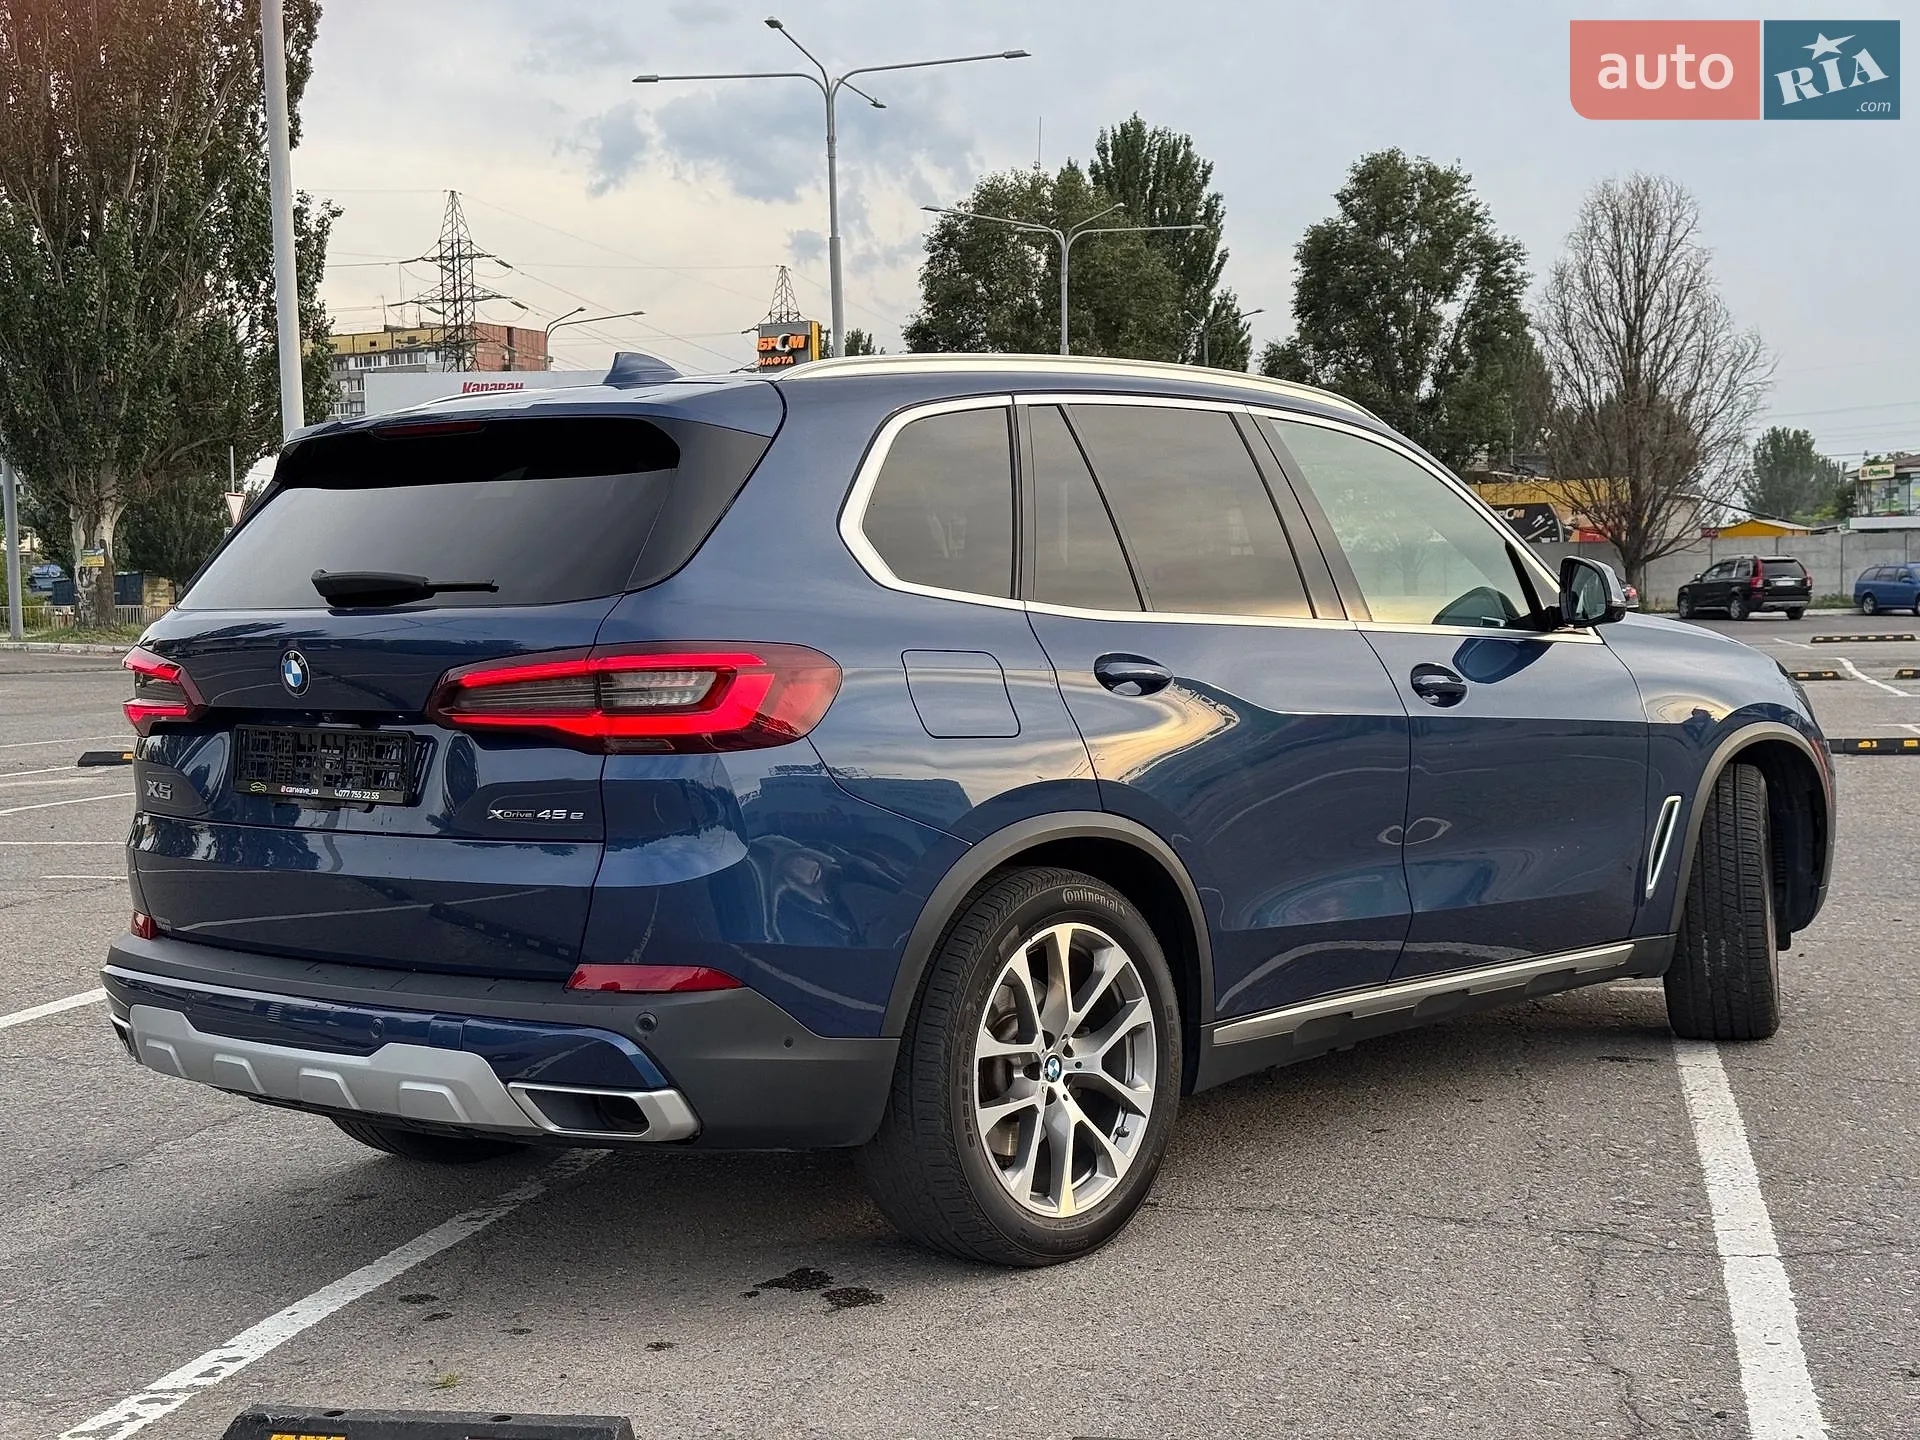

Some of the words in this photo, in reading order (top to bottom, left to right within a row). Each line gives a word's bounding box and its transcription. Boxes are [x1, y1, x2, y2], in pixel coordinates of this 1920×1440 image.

[759, 356, 794, 366] НАФТА
[146, 780, 171, 800] X5
[362, 791, 371, 799] 22
[371, 791, 380, 800] 55
[1062, 887, 1118, 913] Continental
